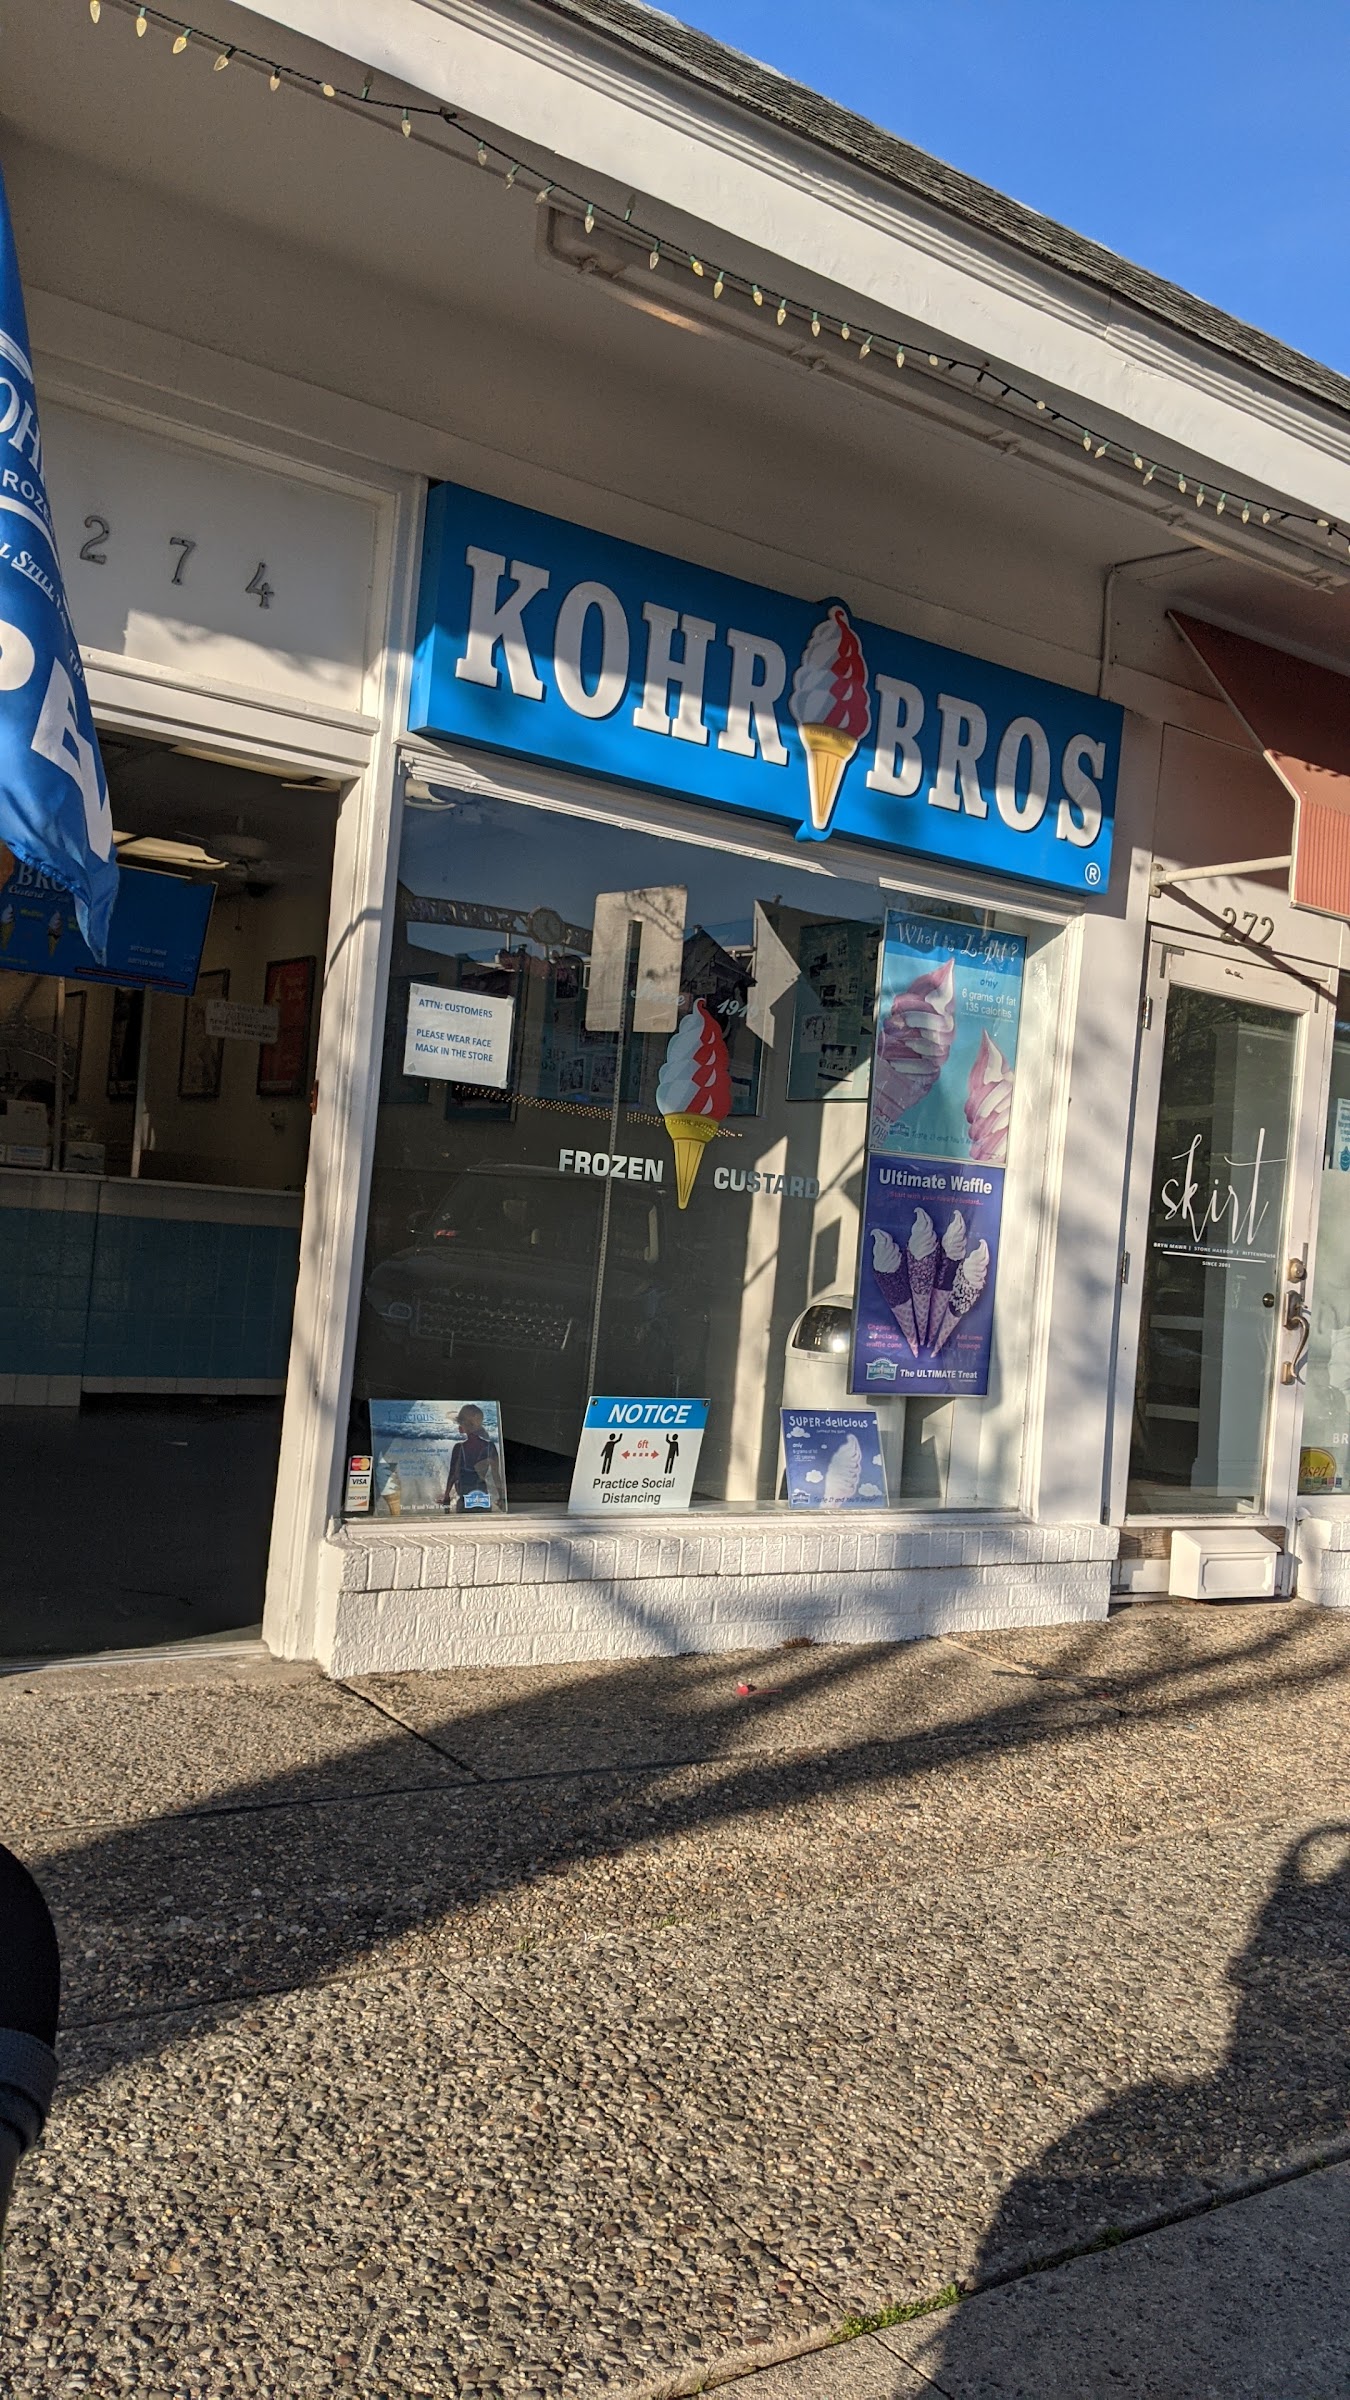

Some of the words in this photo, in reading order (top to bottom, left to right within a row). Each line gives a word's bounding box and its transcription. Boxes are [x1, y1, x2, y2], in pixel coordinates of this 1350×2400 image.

[455, 544, 789, 766] KOHR
[867, 674, 1106, 847] BROS
[17, 863, 66, 892] BRO
[896, 922, 938, 947] What
[1220, 907, 1275, 952] 272
[980, 979, 998, 989] only
[962, 988, 967, 998] 6
[969, 992, 994, 1002] grams
[996, 995, 1005, 1004] of
[1006, 995, 1016, 1006] fat
[419, 998, 443, 1010] ATTN:
[444, 1003, 493, 1018] CUSTOMERS
[966, 1002, 979, 1012] 135
[981, 1006, 1012, 1018] calories
[416, 1028, 445, 1040] PLEASE
[446, 1033, 470, 1044] WEAR
[472, 1037, 491, 1047] FACE
[415, 1043, 438, 1053] MASK
[440, 1047, 449, 1055] IN
[452, 1048, 466, 1058] THE
[468, 1051, 493, 1062] STORE
[558, 1148, 664, 1183] FROZEN
[713, 1167, 821, 1198] CUSTARD
[880, 1168, 946, 1190] Ultimate
[950, 1175, 992, 1194] Waffle
[1161, 1127, 1287, 1245] skirt
[1242, 1250, 1276, 1259] RITTENHOUSE
[900, 1369, 914, 1377] The
[916, 1369, 956, 1378] ULTIMATE
[957, 1370, 978, 1379] Treat
[608, 1404, 692, 1424] NOTICE
[789, 1416, 868, 1428] SUPER-delicious
[637, 1439, 649, 1449] 6ft
[592, 1478, 639, 1489] Practice
[641, 1477, 675, 1489] Social
[601, 1493, 661, 1505] Distancing
